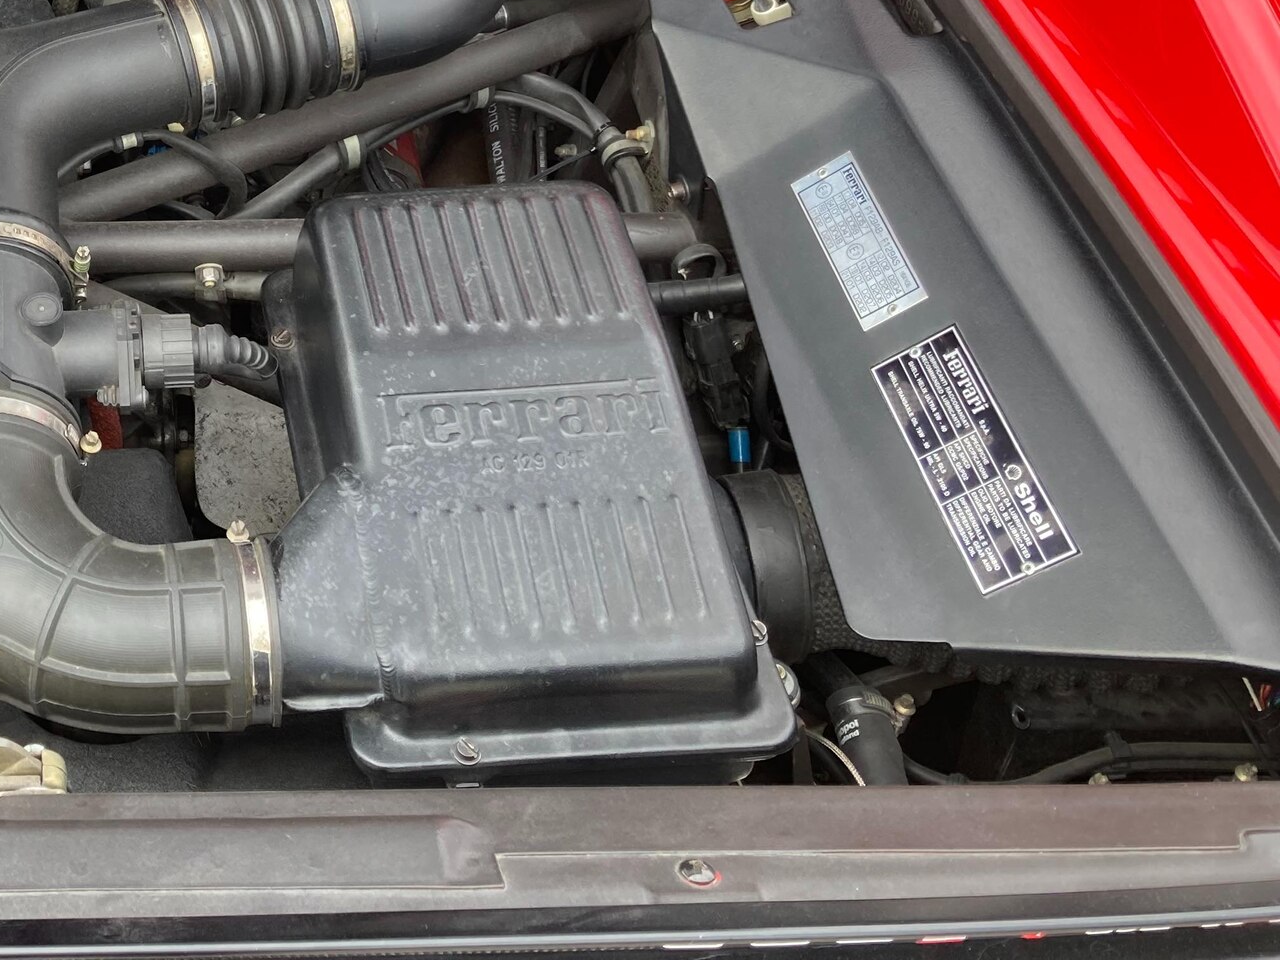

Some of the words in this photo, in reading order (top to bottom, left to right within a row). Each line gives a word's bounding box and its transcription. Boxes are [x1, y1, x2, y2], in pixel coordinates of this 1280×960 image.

[492, 141, 506, 183] WALTON
[841, 166, 870, 206] Ferrari
[887, 371, 898, 387] SHELL
[896, 387, 913, 417] TRANSAXLE
[910, 417, 918, 426] OIL
[908, 360, 919, 378] SHELL
[916, 377, 927, 394] HELIX
[924, 393, 936, 412] ULTRA
[920, 354, 943, 393] RECOMMENDED
[940, 394, 961, 427] LUBRICANTS
[926, 351, 947, 386] LUBRIFICANTI
[944, 386, 969, 428] RACCOMANDATI
[942, 347, 988, 414] Ferrari
[377, 377, 670, 452] Ferrari
[513, 452, 546, 472] 129
[963, 437, 988, 479] SPECIFICATIONS
[969, 434, 989, 464] SPECIFICHE
[946, 503, 970, 545] TRANSMISSION
[967, 545, 975, 557] OIL
[971, 491, 985, 513] ENGINE
[982, 513, 990, 524] OIL
[977, 488, 988, 502] OLIO
[985, 502, 1001, 528] MOTORE
[987, 483, 1000, 502] PARTS
[997, 502, 1005, 511] TO
[1002, 512, 1010, 521] BE
[1007, 521, 1030, 558] LUBRICATED
[994, 480, 1006, 497] PARTI
[1003, 497, 1011, 507] DA
[1008, 507, 1032, 546] LUBRIFICARE
[1013, 482, 1053, 539] Shell
[952, 500, 974, 540] DIFFERENTIAL
[972, 540, 984, 557] GEAR
[981, 559, 992, 571] AND
[984, 547, 1000, 570] CAMBIO
